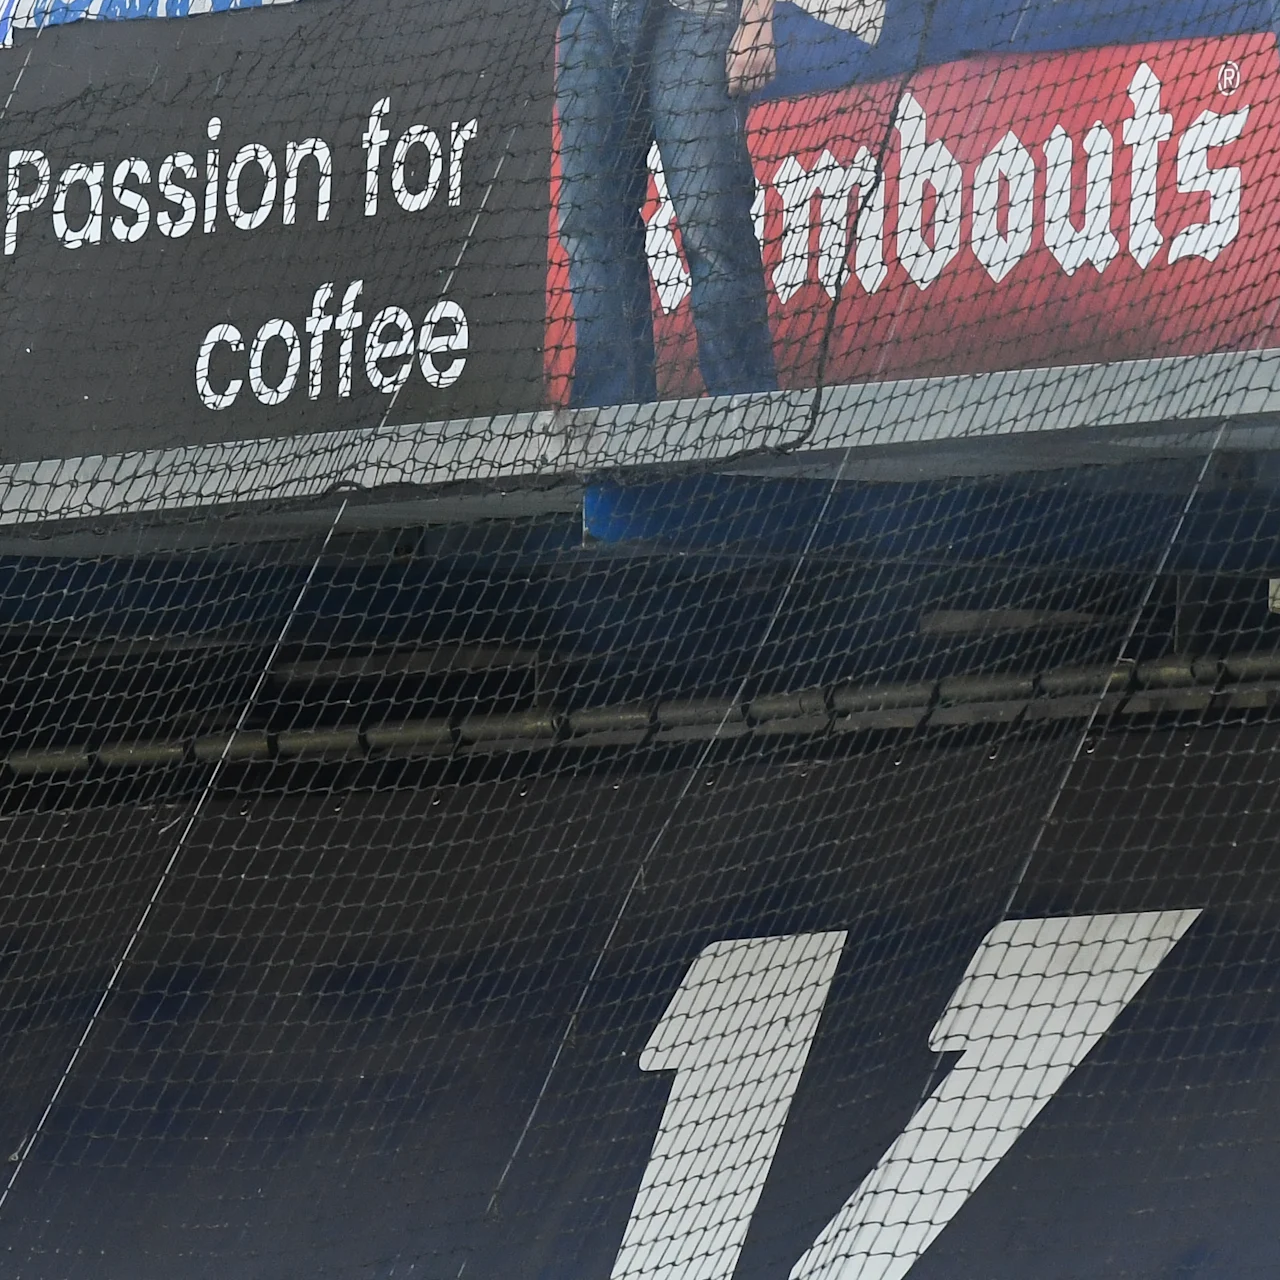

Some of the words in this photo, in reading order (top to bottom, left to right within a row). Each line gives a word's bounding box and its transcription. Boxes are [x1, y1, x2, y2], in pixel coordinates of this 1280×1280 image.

[4, 117, 330, 256] Passion
[361, 97, 479, 217] for
[640, 61, 1252, 314] mbouts
[195, 280, 470, 411] coffee
